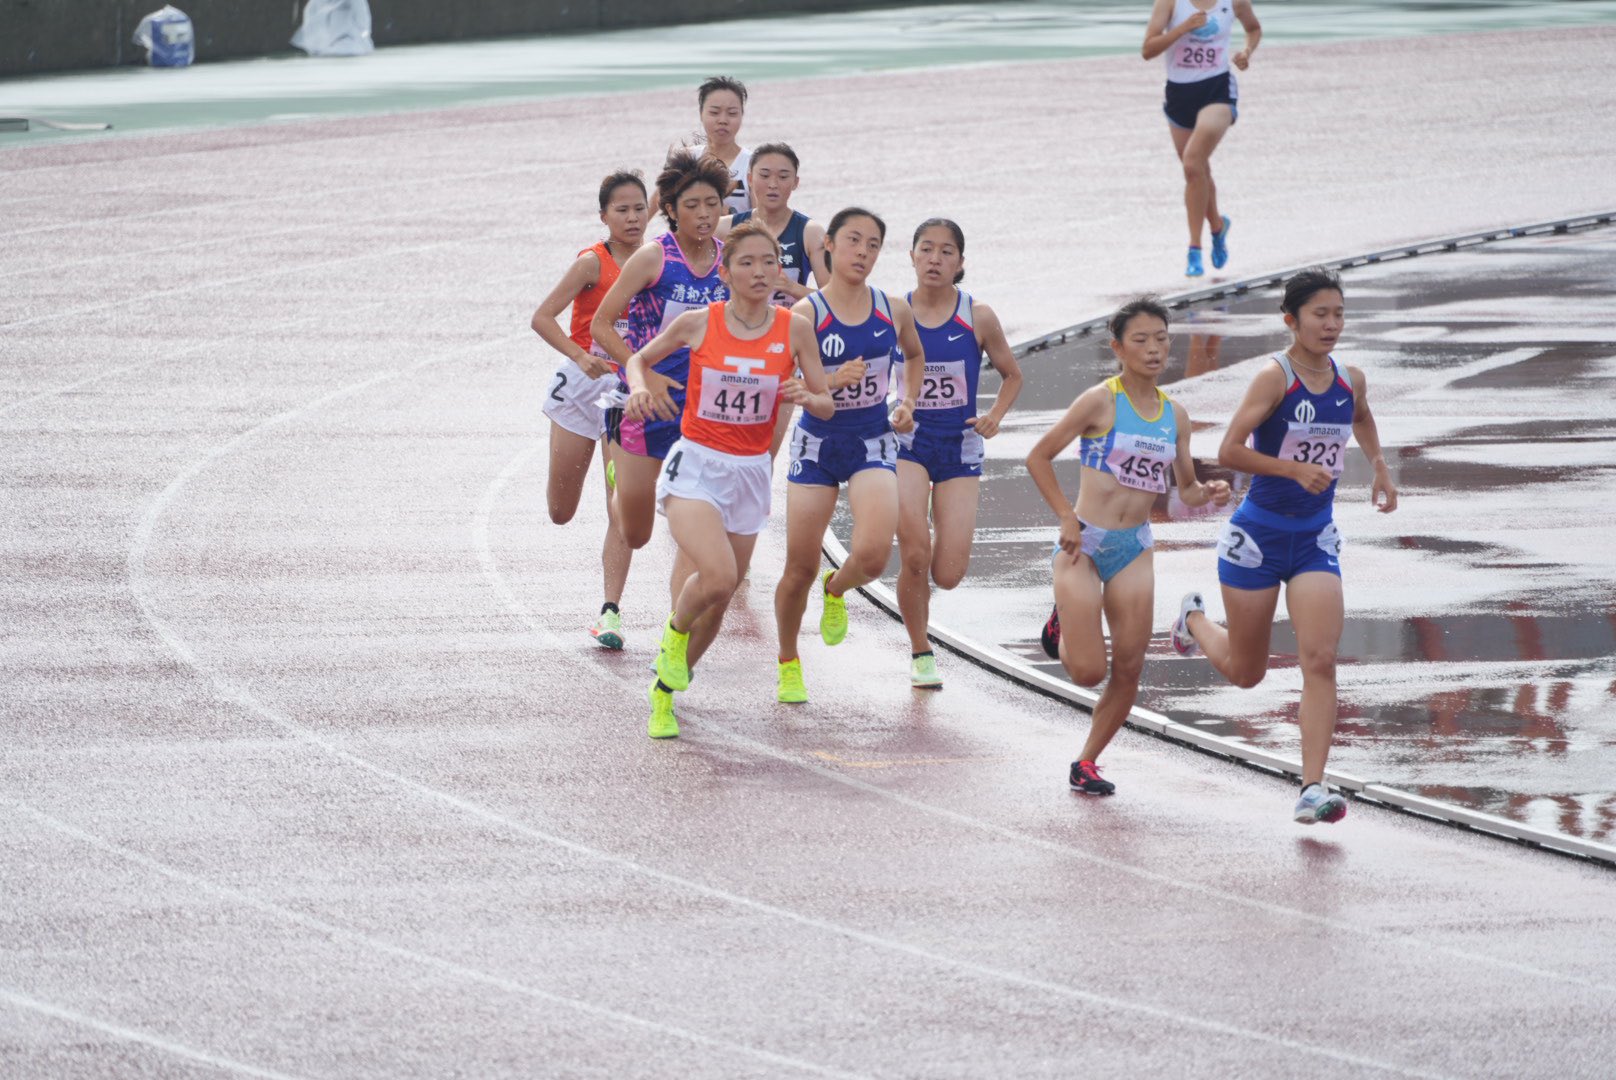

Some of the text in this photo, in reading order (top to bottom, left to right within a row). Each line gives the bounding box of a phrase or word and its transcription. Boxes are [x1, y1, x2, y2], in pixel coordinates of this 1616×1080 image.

[1183, 47, 1216, 64] 269
[671, 283, 726, 303] 清和大学
[550, 372, 567, 402] 2
[720, 374, 759, 385] amazon
[917, 376, 955, 400] 25
[714, 389, 761, 414] 441
[1308, 426, 1341, 436] amazon
[1134, 440, 1165, 453] amazon
[1293, 441, 1341, 467] 323
[665, 450, 684, 483] 4
[1120, 455, 1164, 482] 456
[1226, 531, 1245, 562] 2
